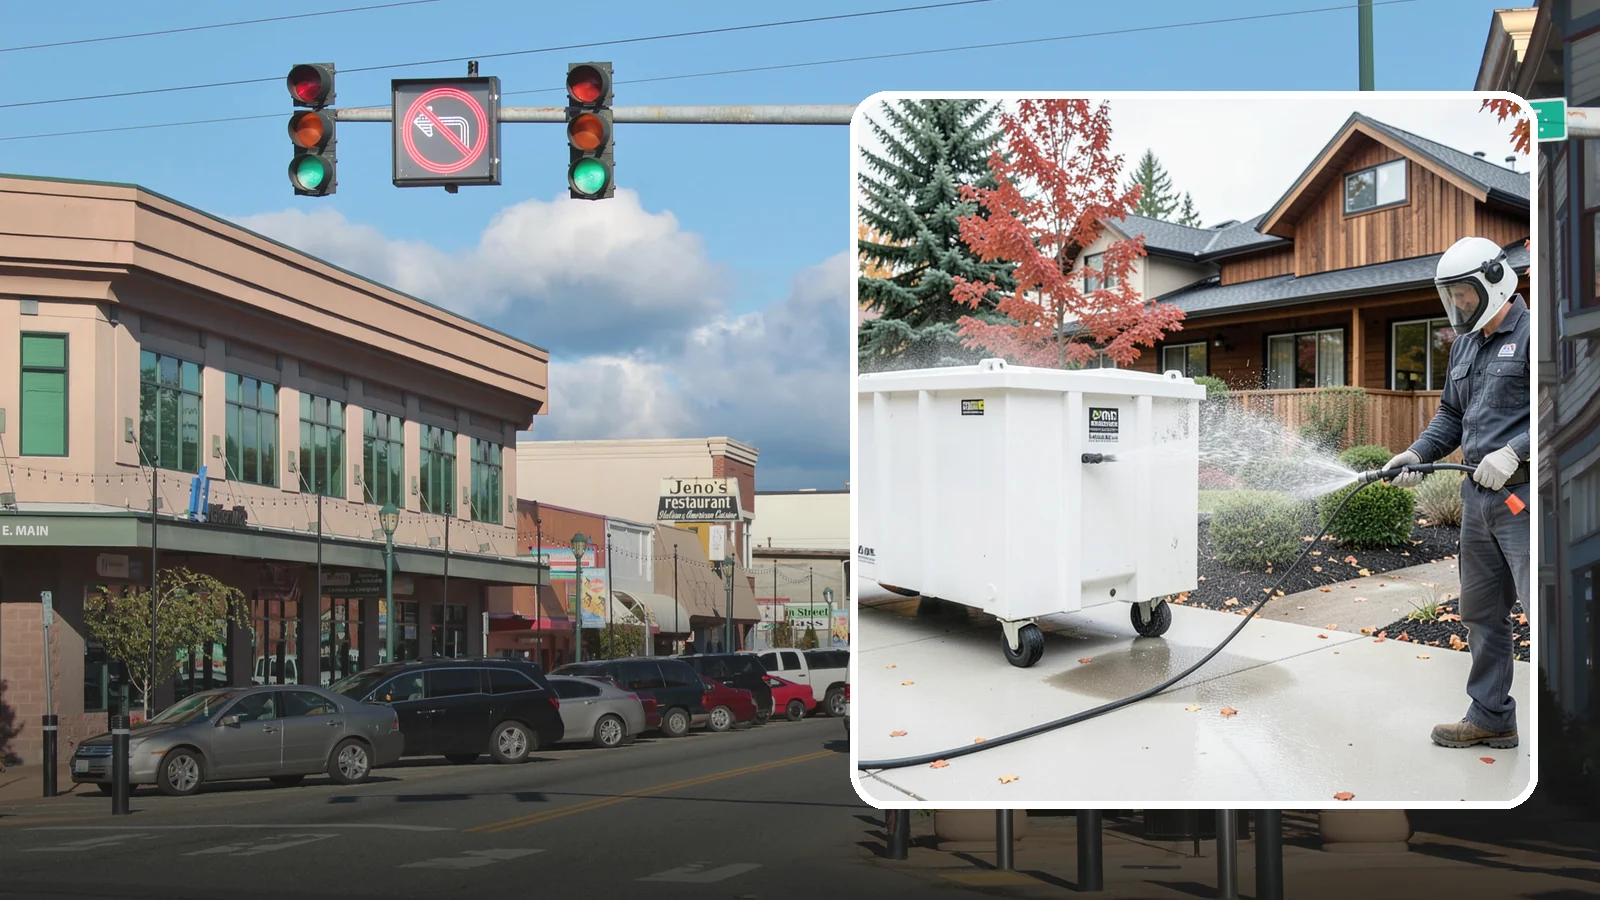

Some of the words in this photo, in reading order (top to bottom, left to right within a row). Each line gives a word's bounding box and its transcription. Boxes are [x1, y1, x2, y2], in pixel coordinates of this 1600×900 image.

[670, 480, 727, 494] Jeno's
[665, 496, 731, 509] restaurant
[686, 509, 714, 519] American
[715, 509, 738, 519] Cuisine
[2, 525, 13, 536] E.
[15, 525, 49, 536] MAIN
[797, 607, 828, 616] Street
[791, 619, 823, 627] lass
